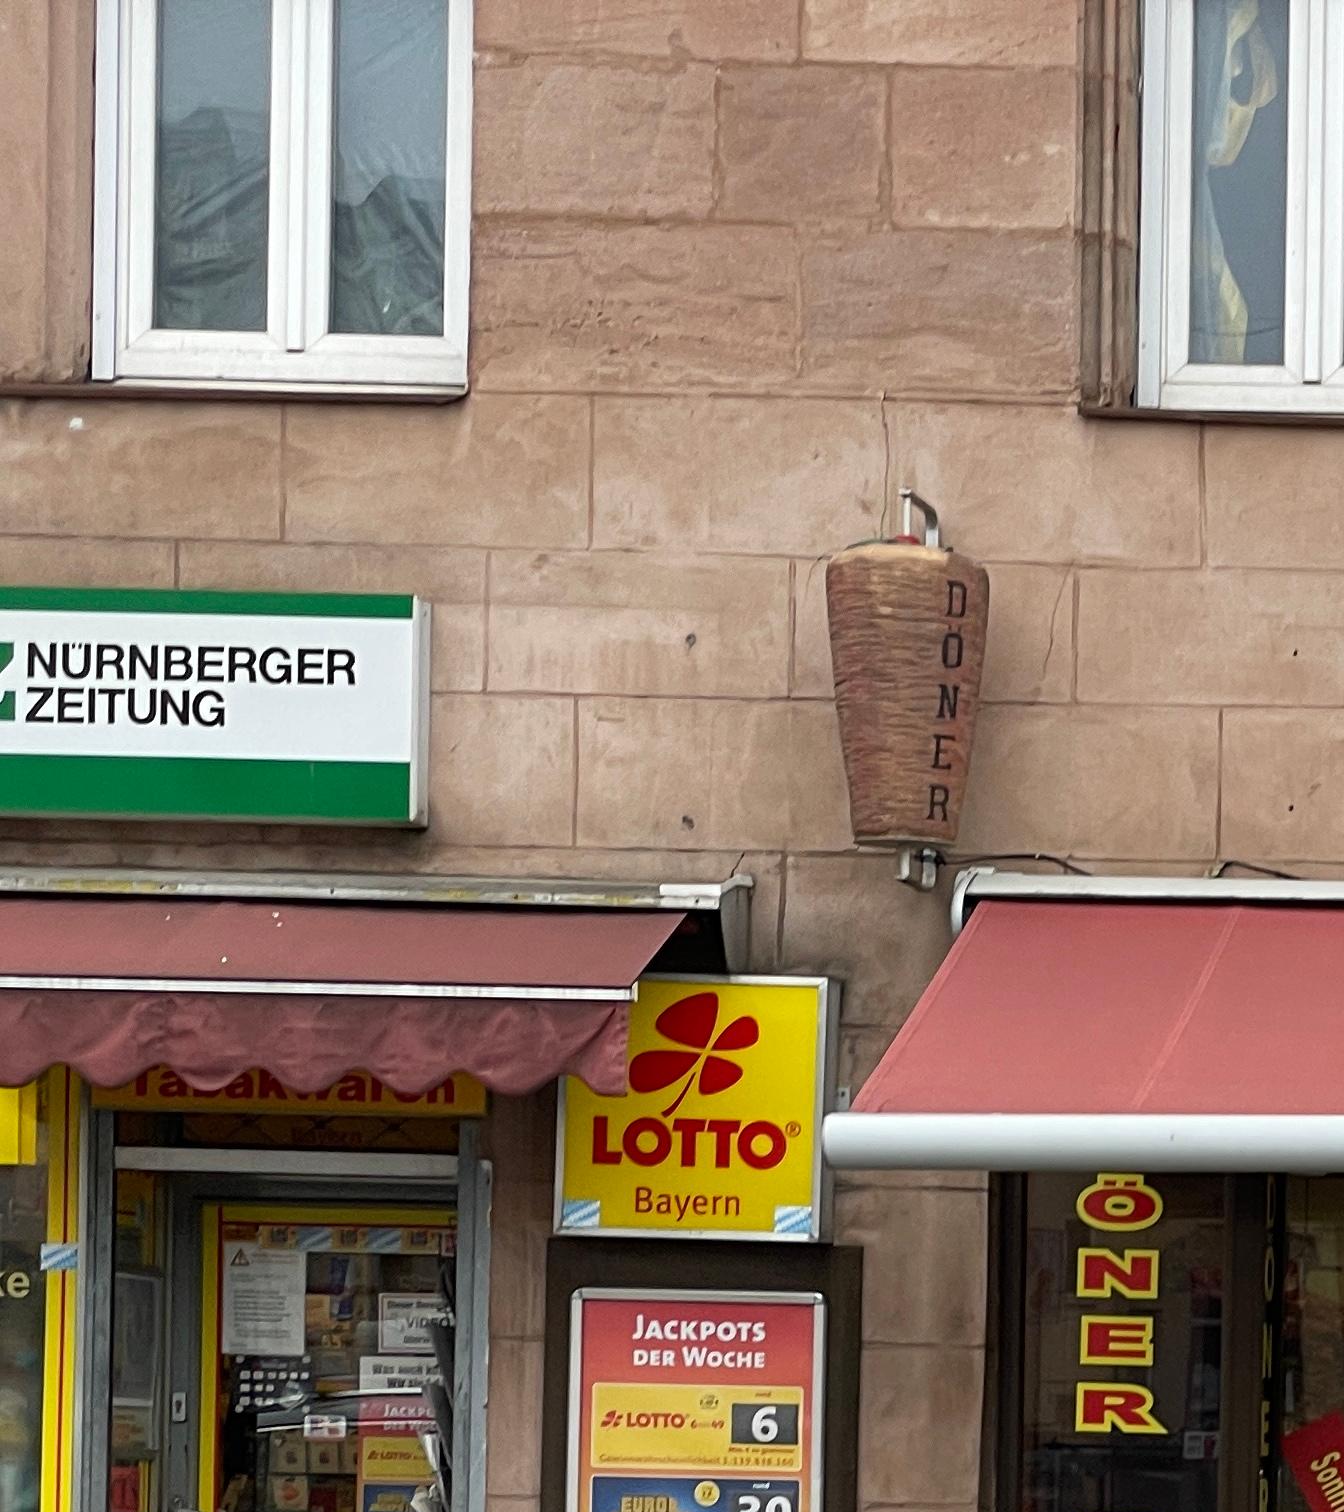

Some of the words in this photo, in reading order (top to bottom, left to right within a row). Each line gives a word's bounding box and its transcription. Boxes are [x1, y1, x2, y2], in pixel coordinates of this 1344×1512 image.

[26, 641, 357, 686] NÜRNBERGER
[25, 687, 226, 727] ZEITUNG
[925, 580, 968, 822] DÖNER
[134, 1067, 456, 1106] Taakarn
[592, 1116, 788, 1169] LOTTO
[635, 1187, 741, 1223] Bayern
[1074, 1173, 1168, 1434] ÖNER
[632, 1315, 767, 1343] JACKPOTS
[633, 1349, 675, 1368] DER
[681, 1347, 766, 1369] WOCHE
[384, 1404, 436, 1418] JACKP
[626, 1412, 686, 1429] LOTTO
[751, 1405, 779, 1443] 6
